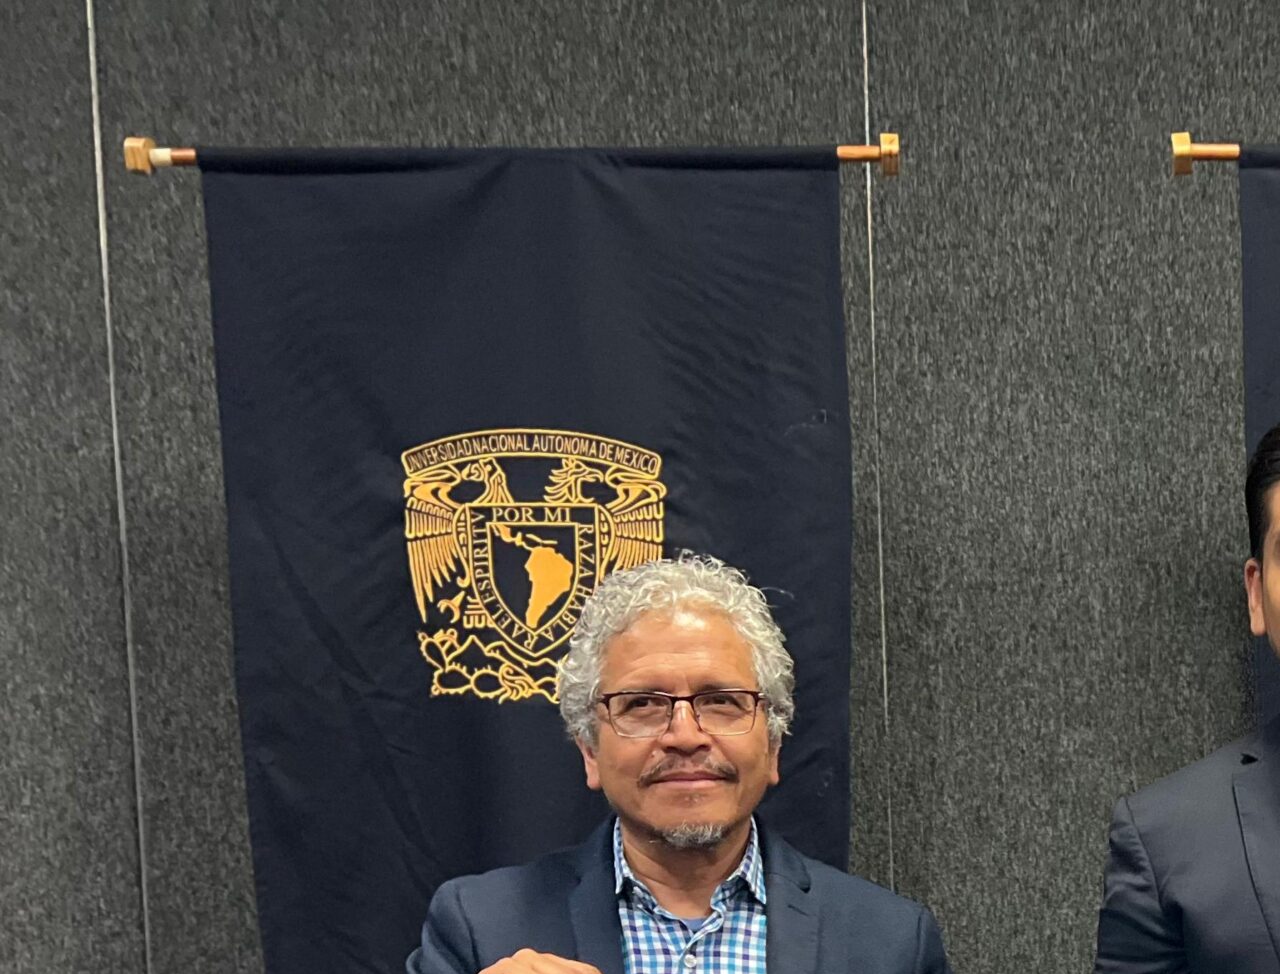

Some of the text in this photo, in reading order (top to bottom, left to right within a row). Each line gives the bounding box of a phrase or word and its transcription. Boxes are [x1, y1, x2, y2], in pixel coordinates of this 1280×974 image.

[406, 434, 658, 474] UNIVERSIDAD NACIONAL AUTONOMA DE MEXICO
[492, 507, 570, 522] POR MI
[579, 524, 595, 578] RAZA
